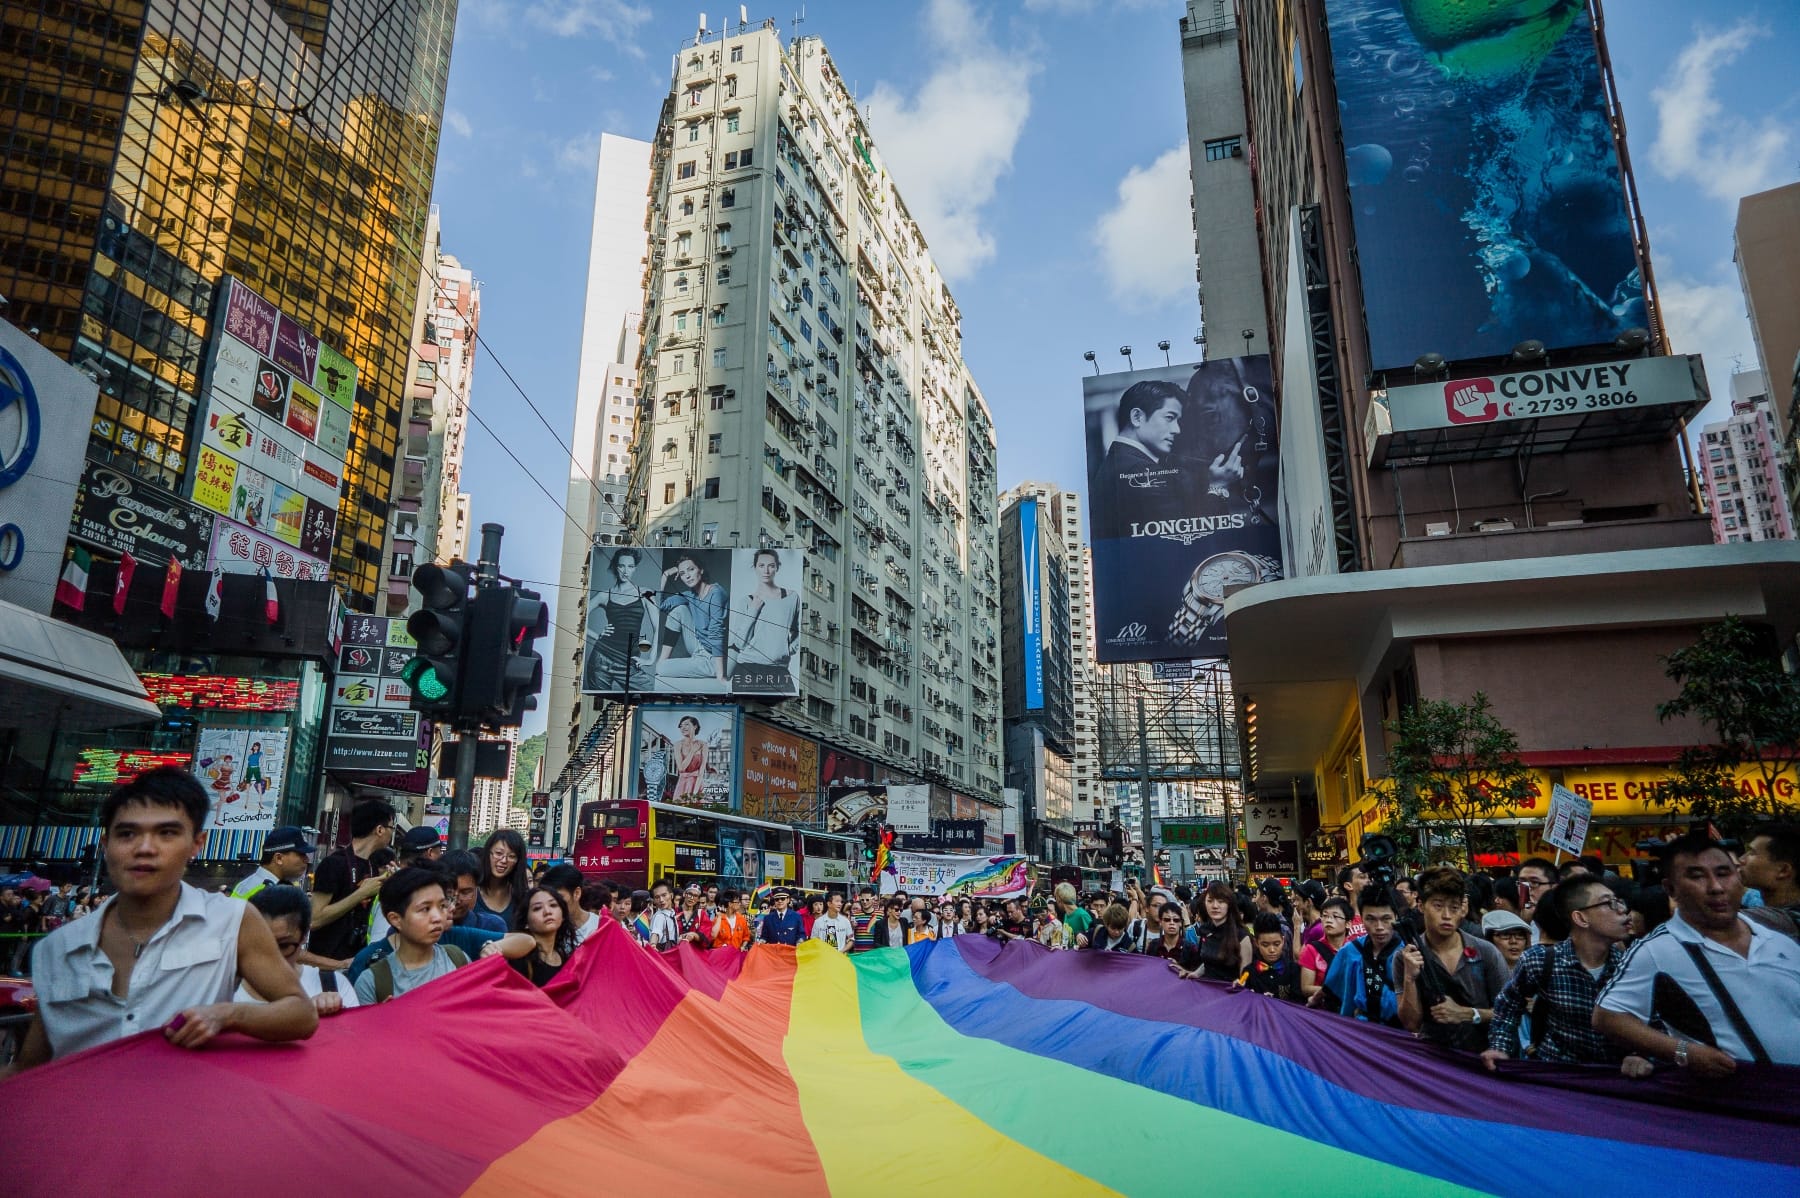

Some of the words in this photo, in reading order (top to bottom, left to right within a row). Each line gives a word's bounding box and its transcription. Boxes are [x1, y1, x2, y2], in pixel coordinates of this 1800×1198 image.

[233, 282, 258, 317] THAI
[1500, 364, 1631, 399] CONVEY
[1527, 398, 1578, 415] 2739
[1585, 391, 1638, 409] 3806
[83, 518, 105, 534] CAFE
[117, 532, 136, 545] BAR
[109, 508, 188, 554] Colours
[1131, 513, 1245, 538] LONGINES
[1117, 622, 1147, 639] 180
[734, 673, 791, 684] ESPRIT
[1574, 783, 1618, 801] BEE
[1251, 807, 1289, 820] 余仁生
[900, 876, 924, 885] Dare
